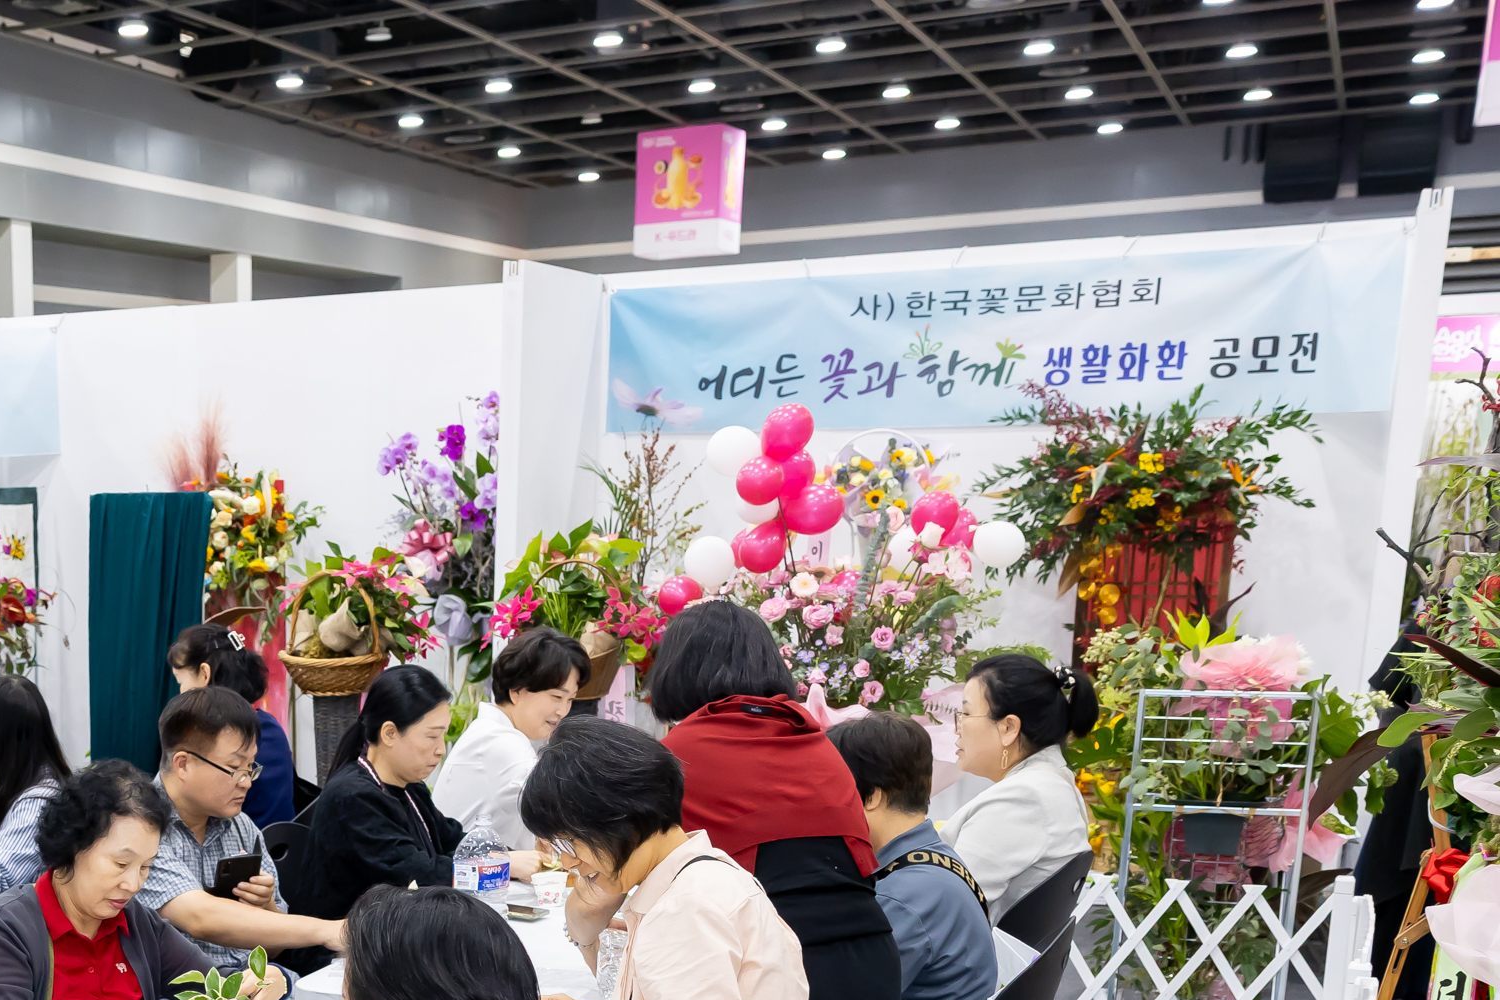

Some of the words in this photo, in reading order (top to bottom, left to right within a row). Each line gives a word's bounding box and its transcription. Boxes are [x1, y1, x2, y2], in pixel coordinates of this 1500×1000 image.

[699, 352, 805, 400] 어디든
[819, 347, 908, 403] 꽃과
[916, 350, 1017, 398] 함께
[1042, 340, 1188, 386] 생활화환
[1209, 331, 1320, 379] 공모전
